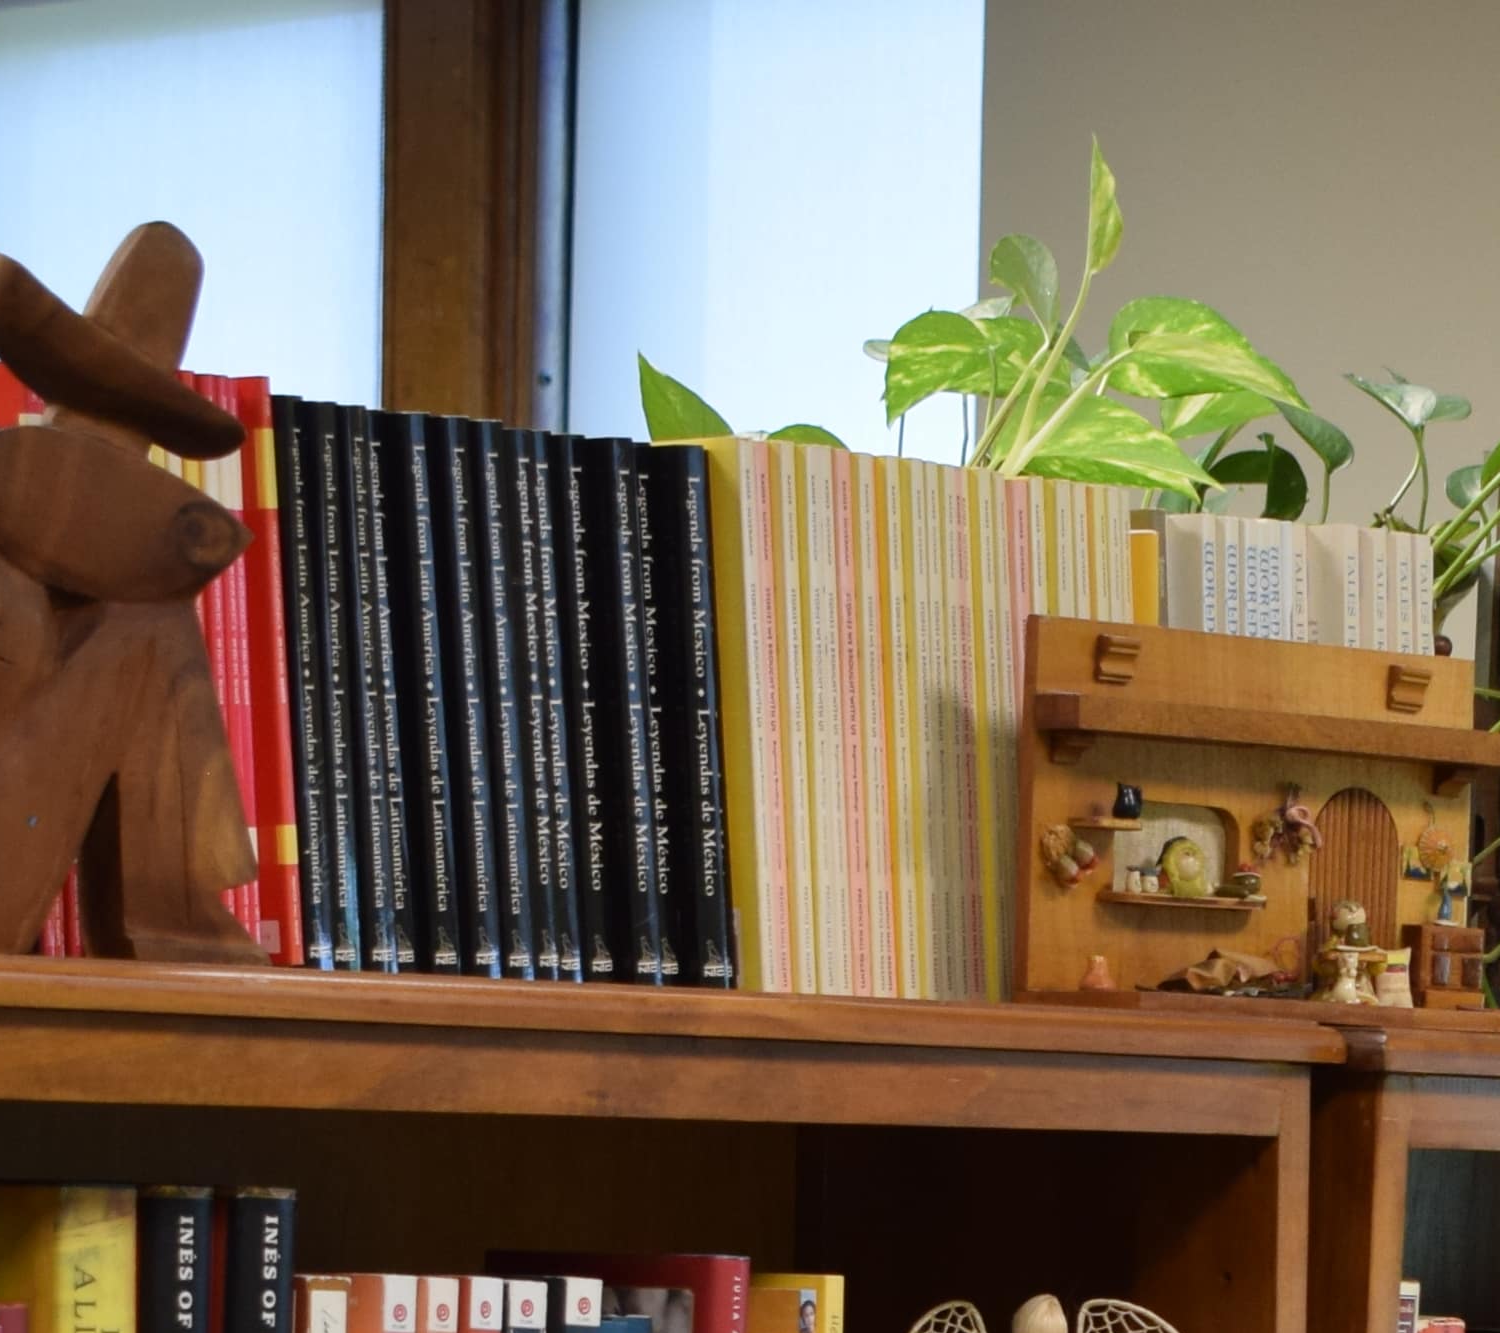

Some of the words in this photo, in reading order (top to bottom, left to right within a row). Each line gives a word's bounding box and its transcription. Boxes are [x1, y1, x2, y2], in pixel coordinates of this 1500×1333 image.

[412, 445, 425, 509] Legends
[416, 515, 428, 556] from
[688, 476, 700, 553] Legends
[419, 559, 429, 602] Latin
[692, 558, 703, 604] from
[421, 606, 433, 677] America
[693, 610, 706, 678] Mexico
[426, 697, 441, 775] Leyendas
[697, 709, 711, 796] Leyendas
[432, 777, 441, 794] de
[700, 801, 711, 822] de
[700, 829, 715, 897] México
[178, 1215, 197, 1281] INÉS
[262, 1215, 281, 1280] INÉS
[177, 1292, 193, 1328] OF
[262, 1291, 277, 1327] OF
[732, 1276, 740, 1320] JULIA
